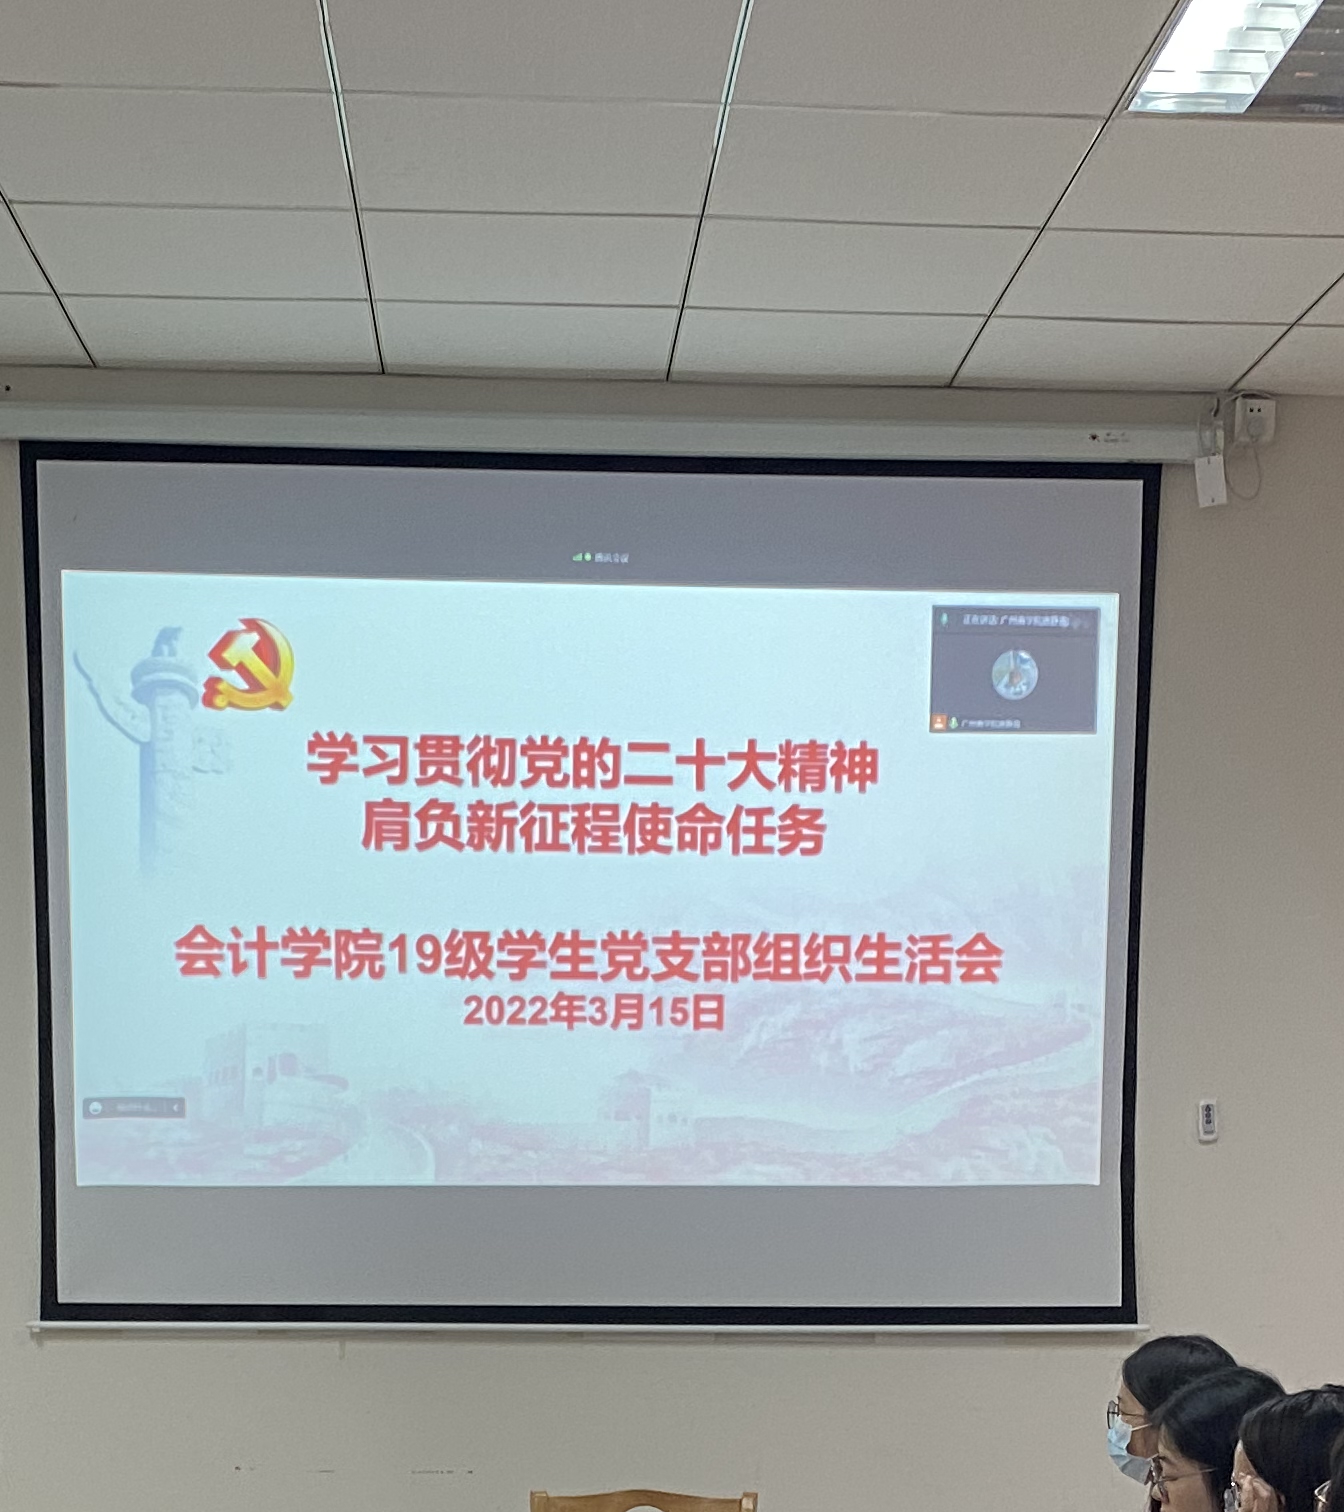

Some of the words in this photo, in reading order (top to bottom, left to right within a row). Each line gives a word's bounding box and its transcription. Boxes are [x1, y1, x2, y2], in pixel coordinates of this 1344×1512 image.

[306, 731, 880, 794] 学习贯彻党的二十大精神
[361, 797, 826, 857] 肩负新征程使命任务
[174, 924, 1003, 985] 会计学院19级学生党支部组织生活会
[463, 992, 725, 1032] 2022年3月15日
